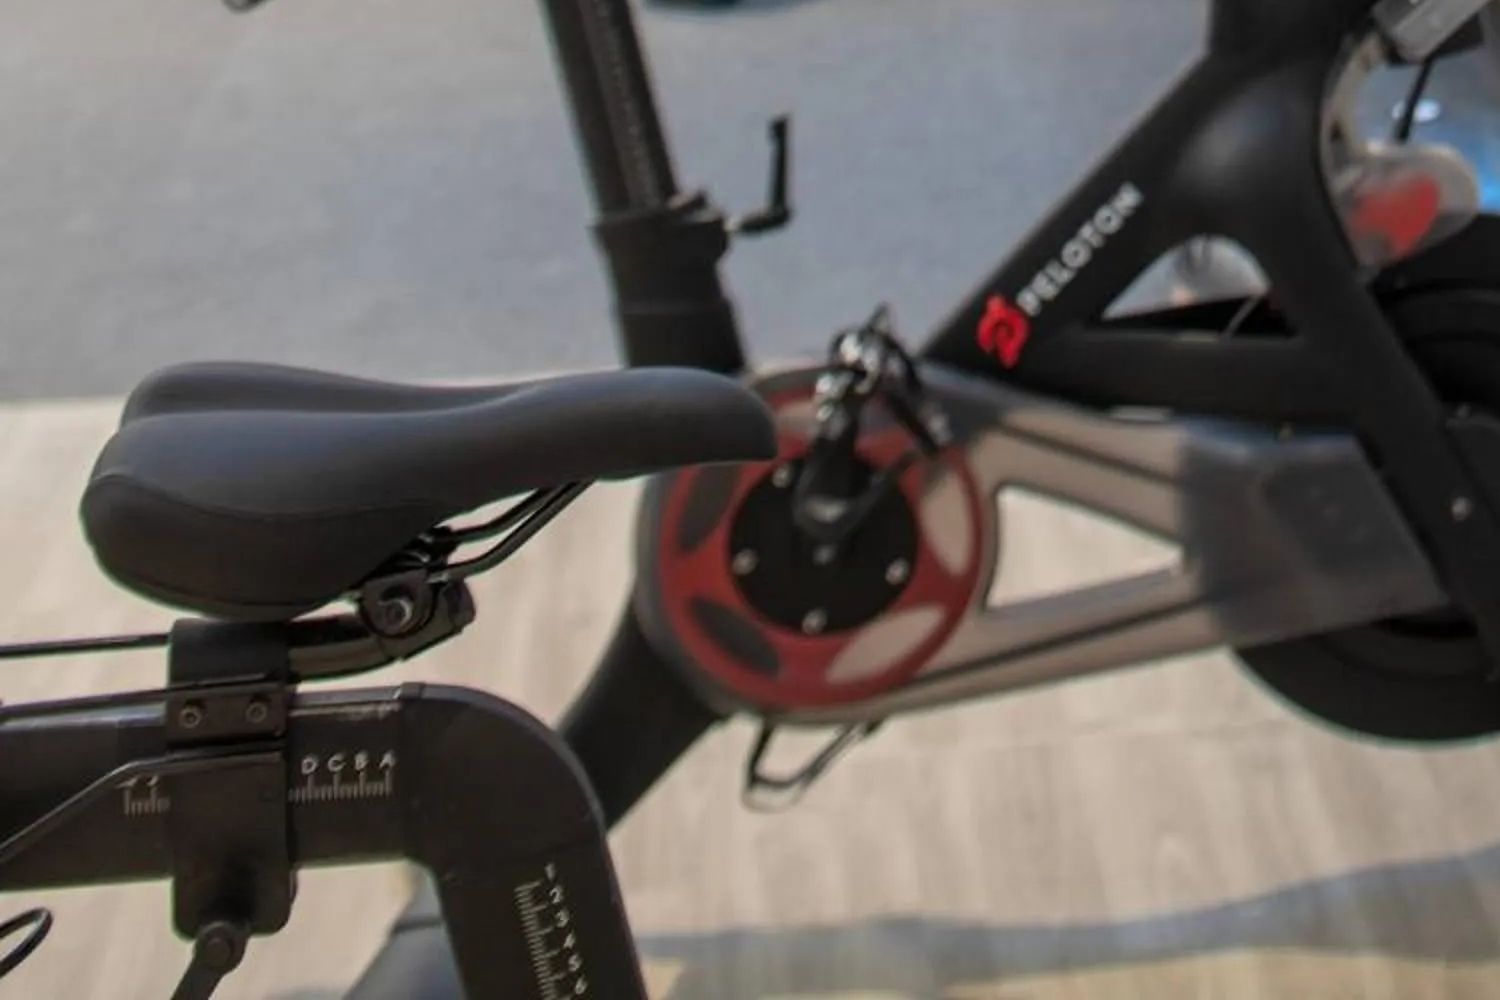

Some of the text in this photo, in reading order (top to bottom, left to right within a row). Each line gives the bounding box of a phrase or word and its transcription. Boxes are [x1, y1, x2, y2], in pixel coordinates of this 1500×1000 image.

[1016, 181, 1142, 317] PELOTON
[301, 756, 318, 775] D
[327, 753, 347, 772] C
